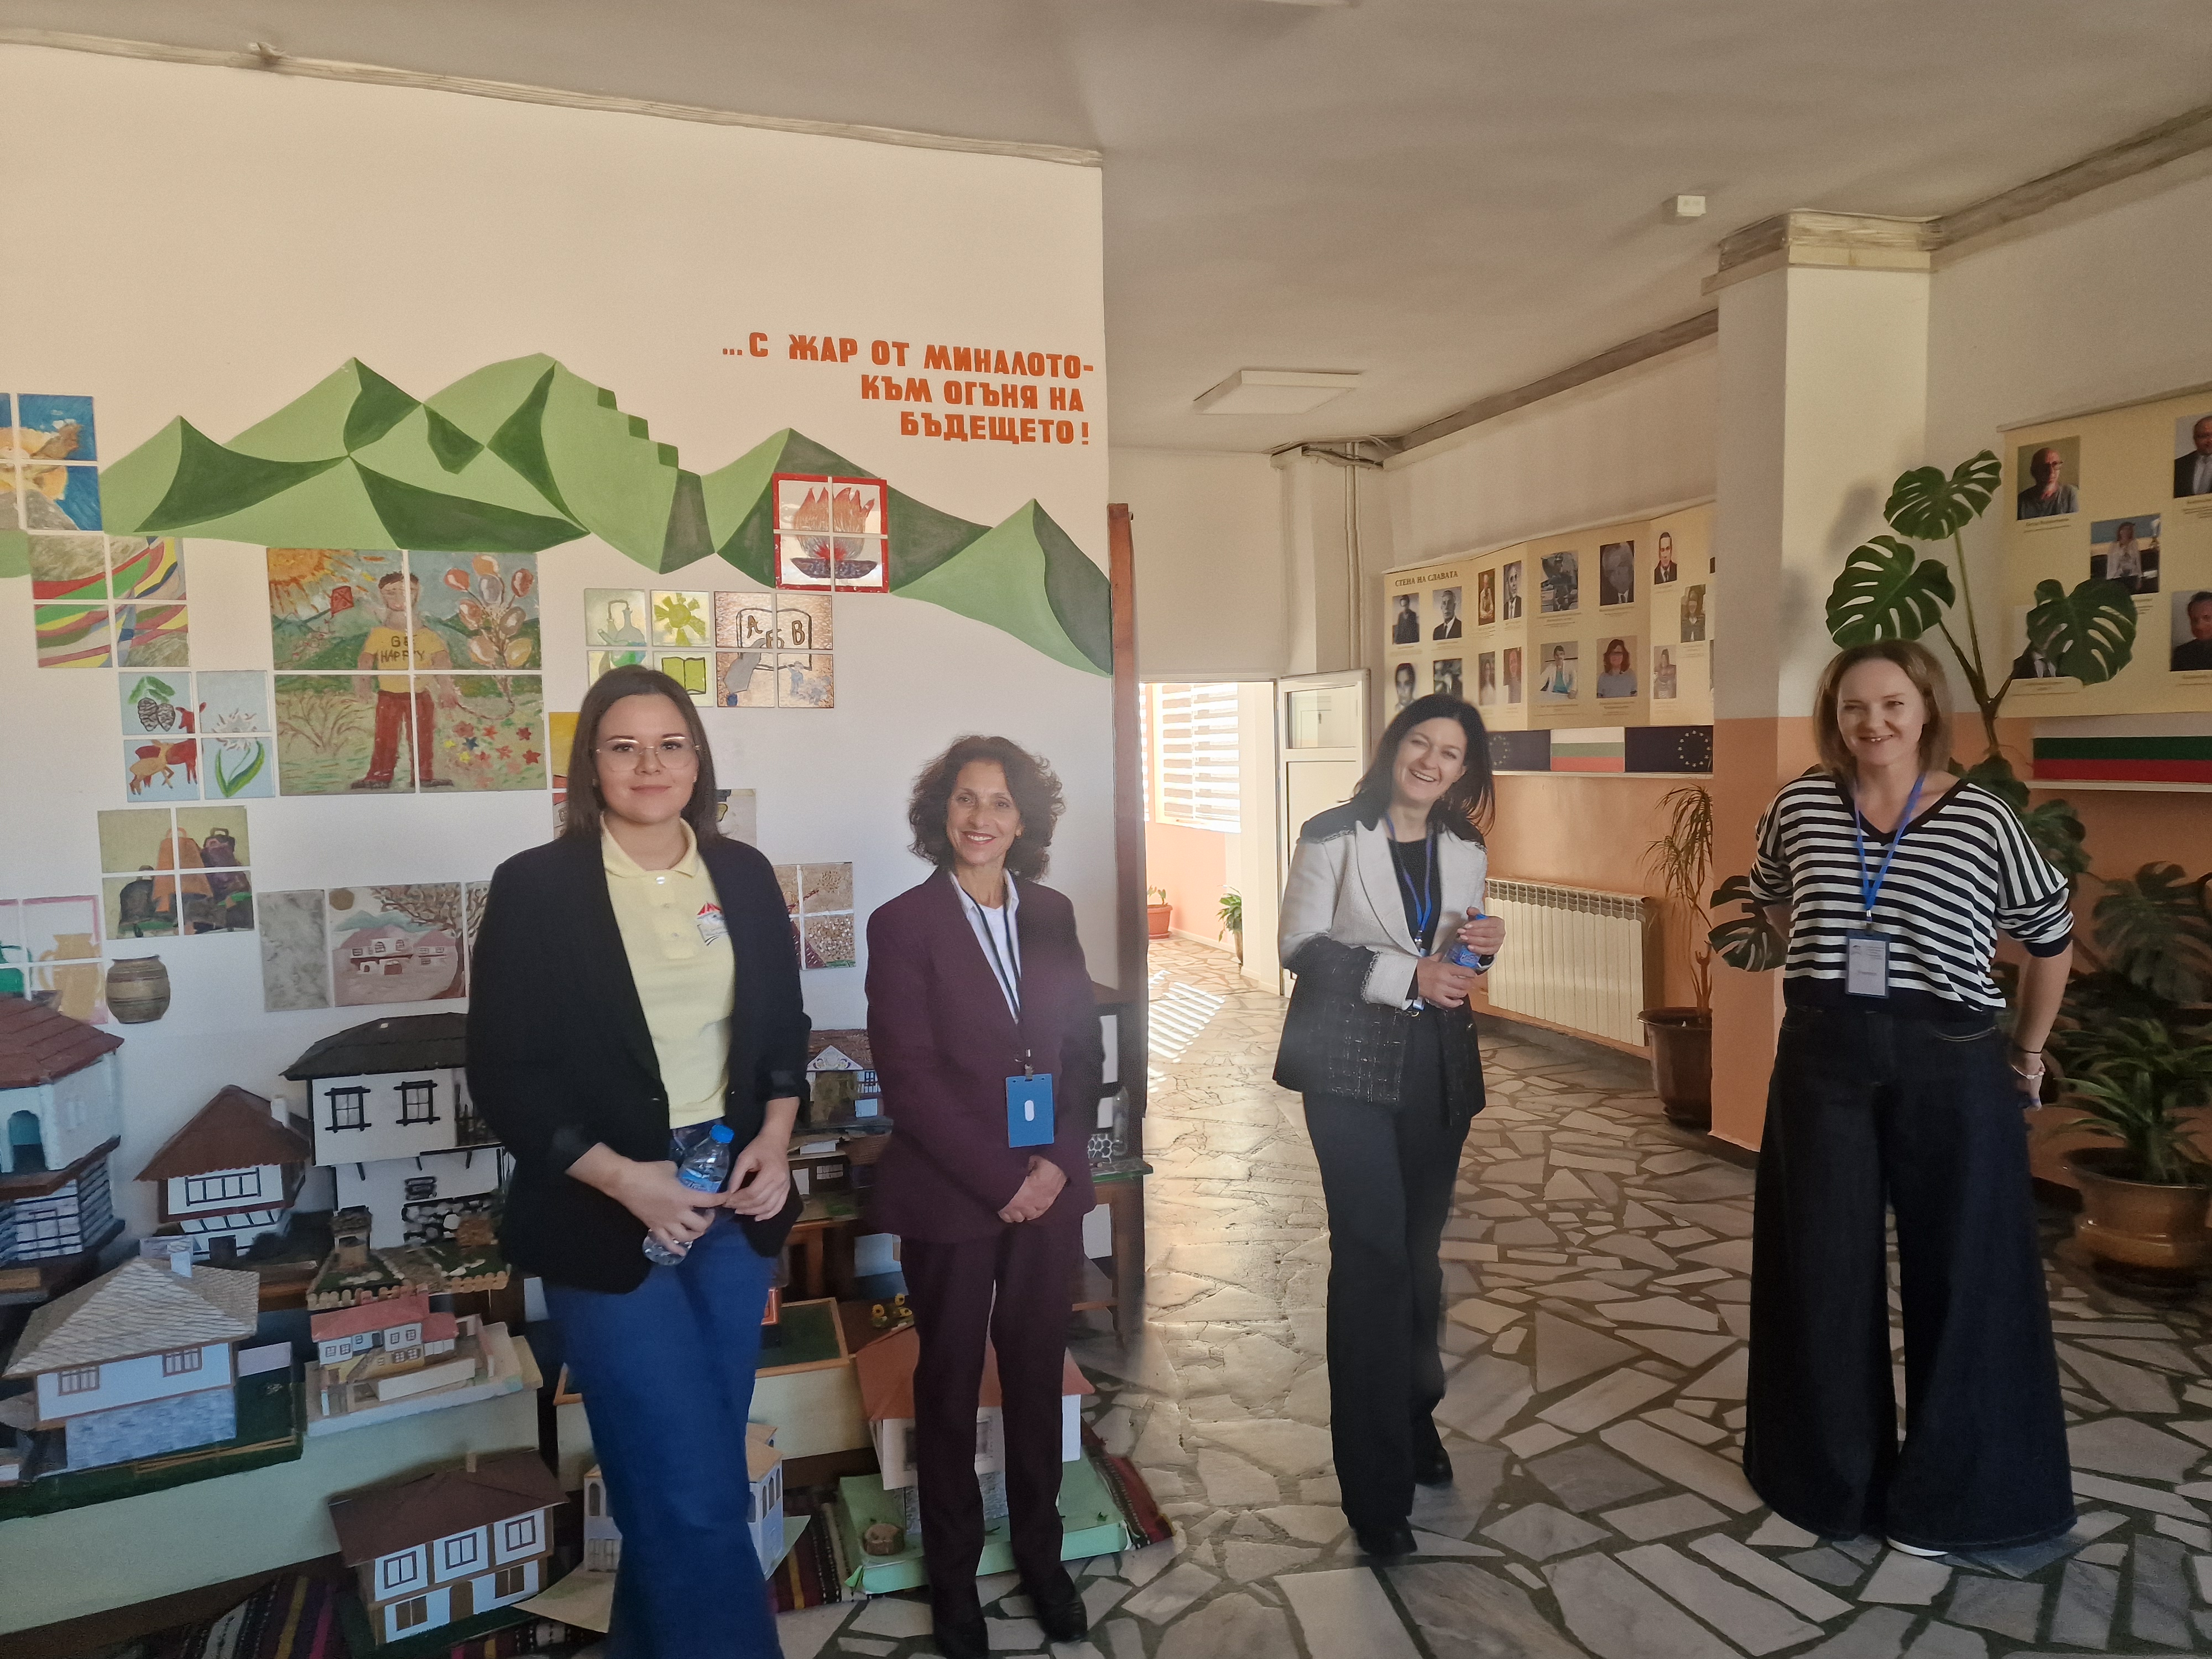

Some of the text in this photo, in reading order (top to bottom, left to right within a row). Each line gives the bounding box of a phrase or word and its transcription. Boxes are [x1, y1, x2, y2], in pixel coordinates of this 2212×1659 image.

[788, 333, 858, 363] ЖАР
[870, 340, 910, 367] ОТ
[923, 343, 1094, 379] МИНАЛОТО-
[860, 374, 1084, 412] КЪМ ОГЪНЯ НА
[900, 410, 1089, 445] БЪДЕЩЕТО!
[1395, 578, 1416, 587] СТЕНА
[1428, 571, 1459, 582] СЛАВАТА
[380, 649, 425, 664] HAPPY
